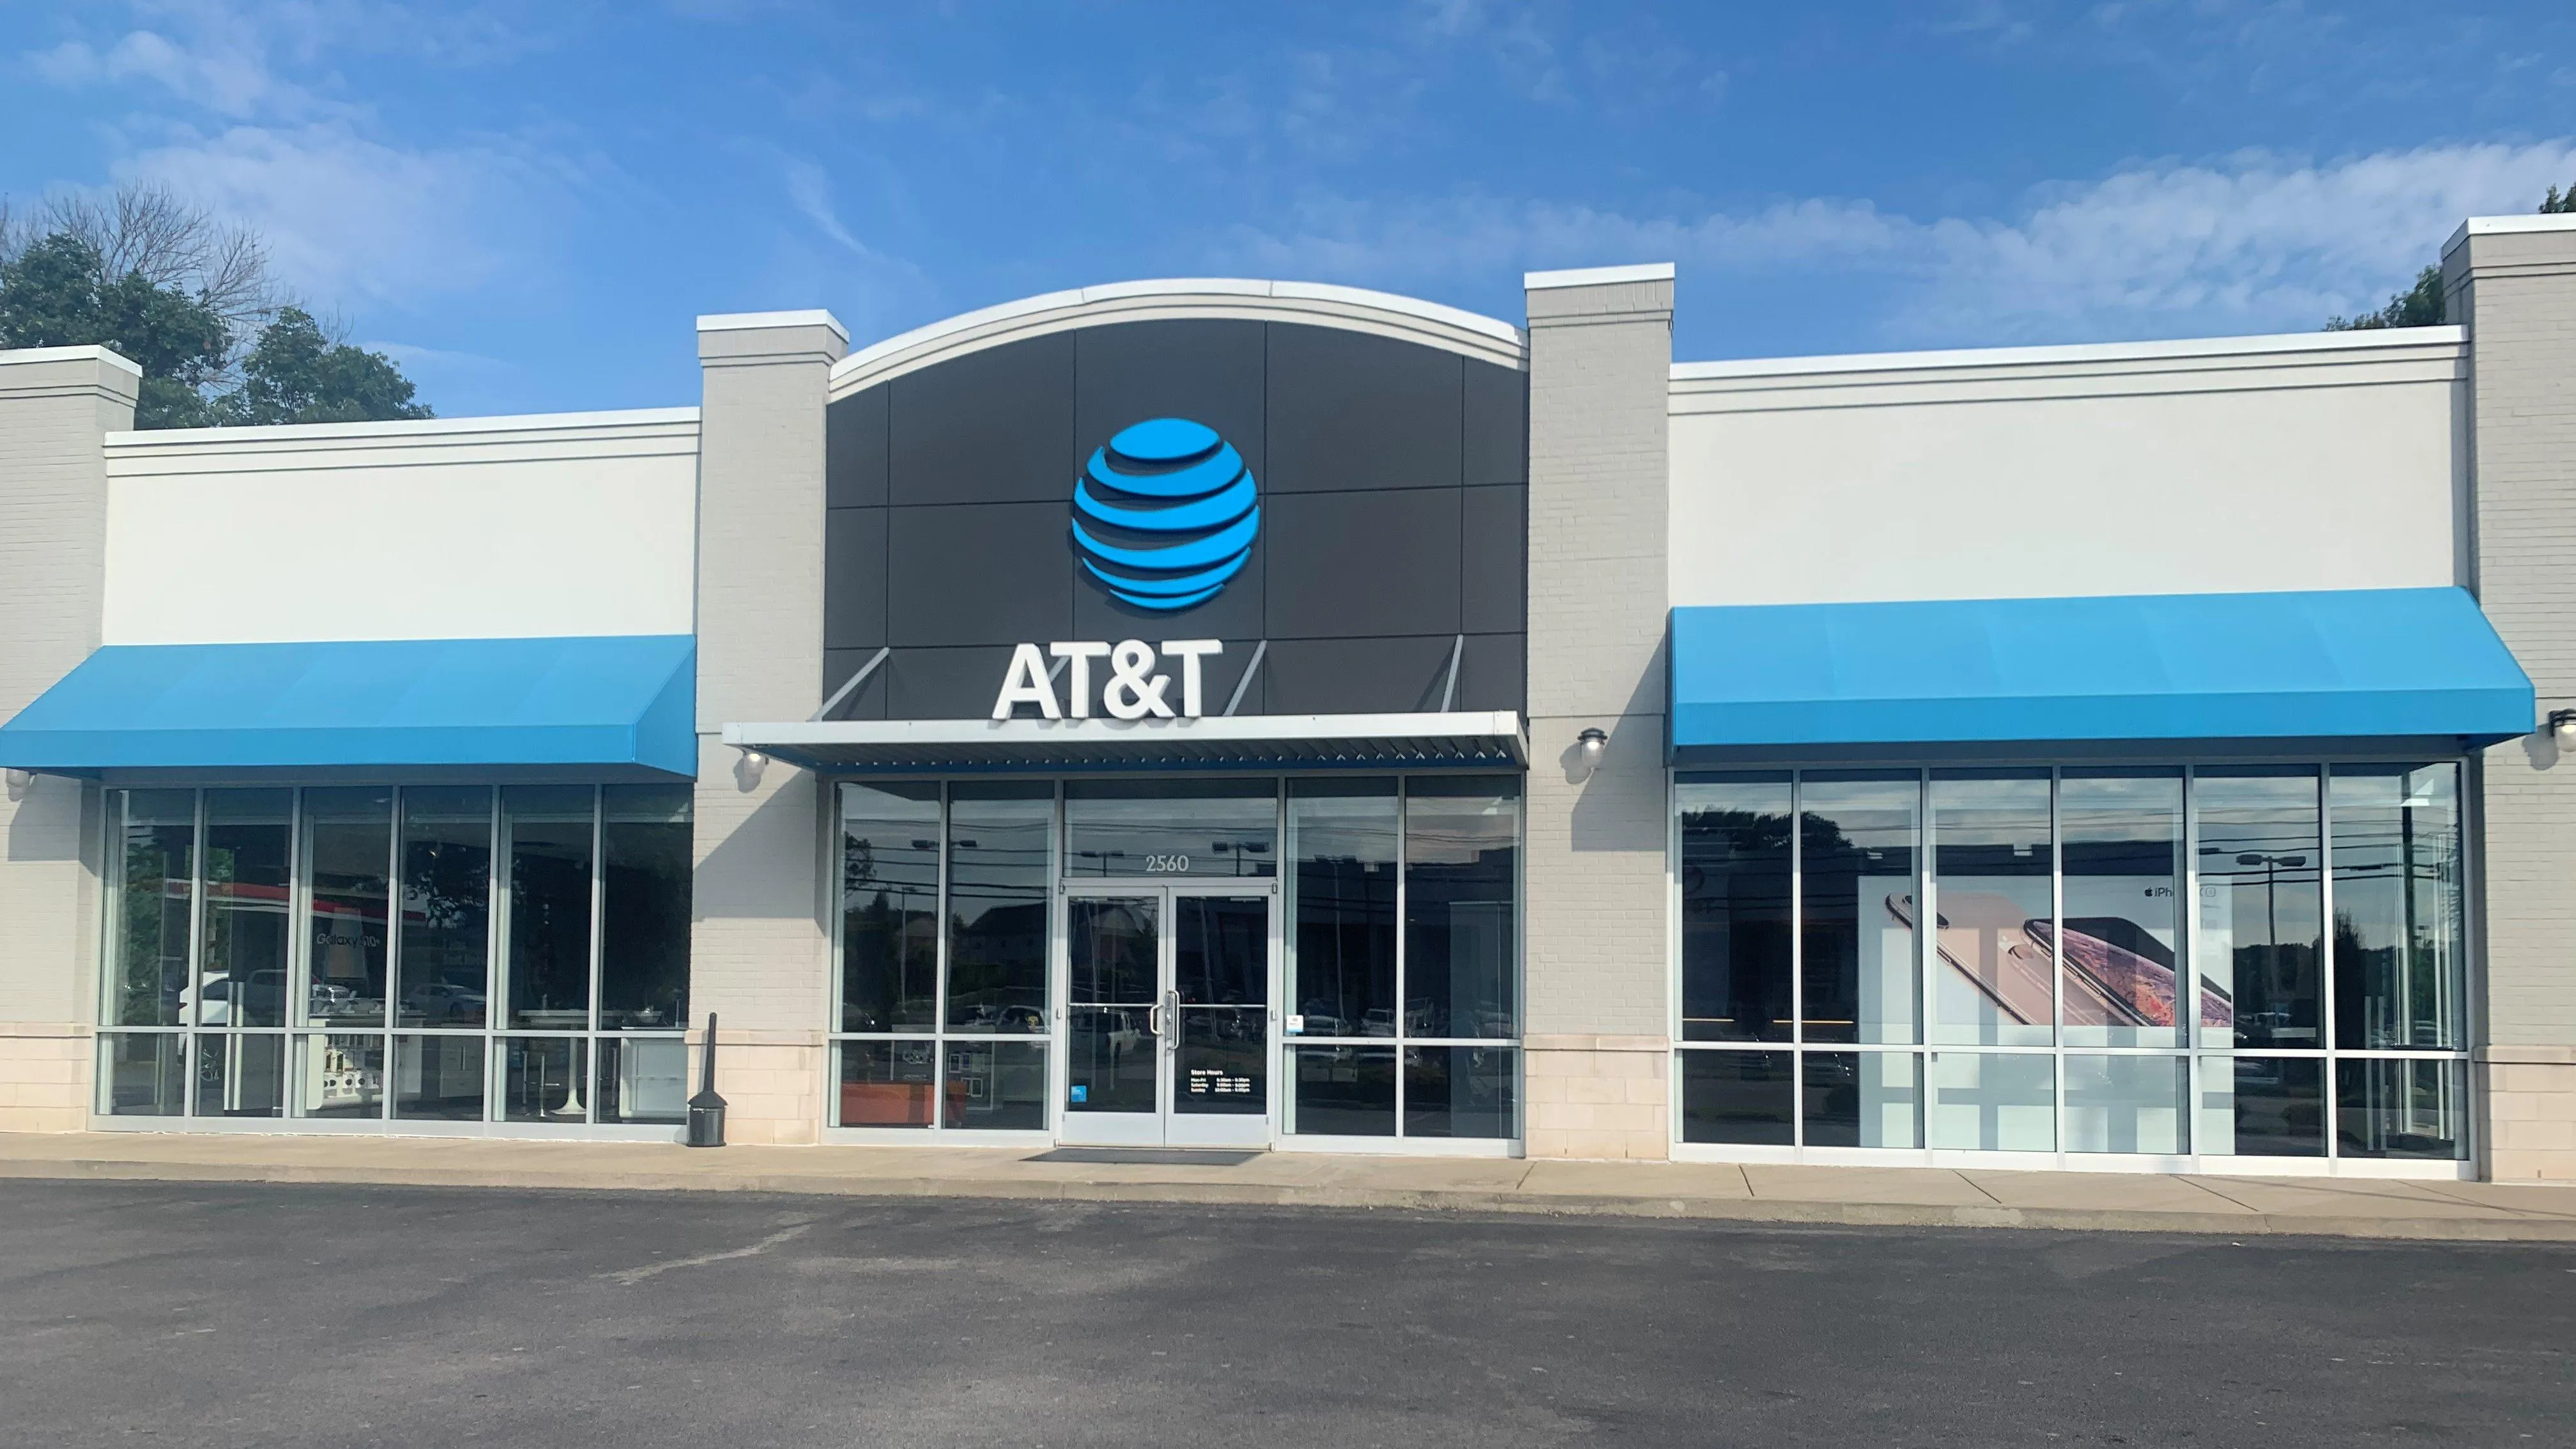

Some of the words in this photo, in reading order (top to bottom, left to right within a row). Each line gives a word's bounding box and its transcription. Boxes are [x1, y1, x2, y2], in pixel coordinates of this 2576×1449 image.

[992, 639, 1223, 720] AT&T
[1146, 855, 1189, 871] 2560
[316, 933, 358, 949] Galaxy
